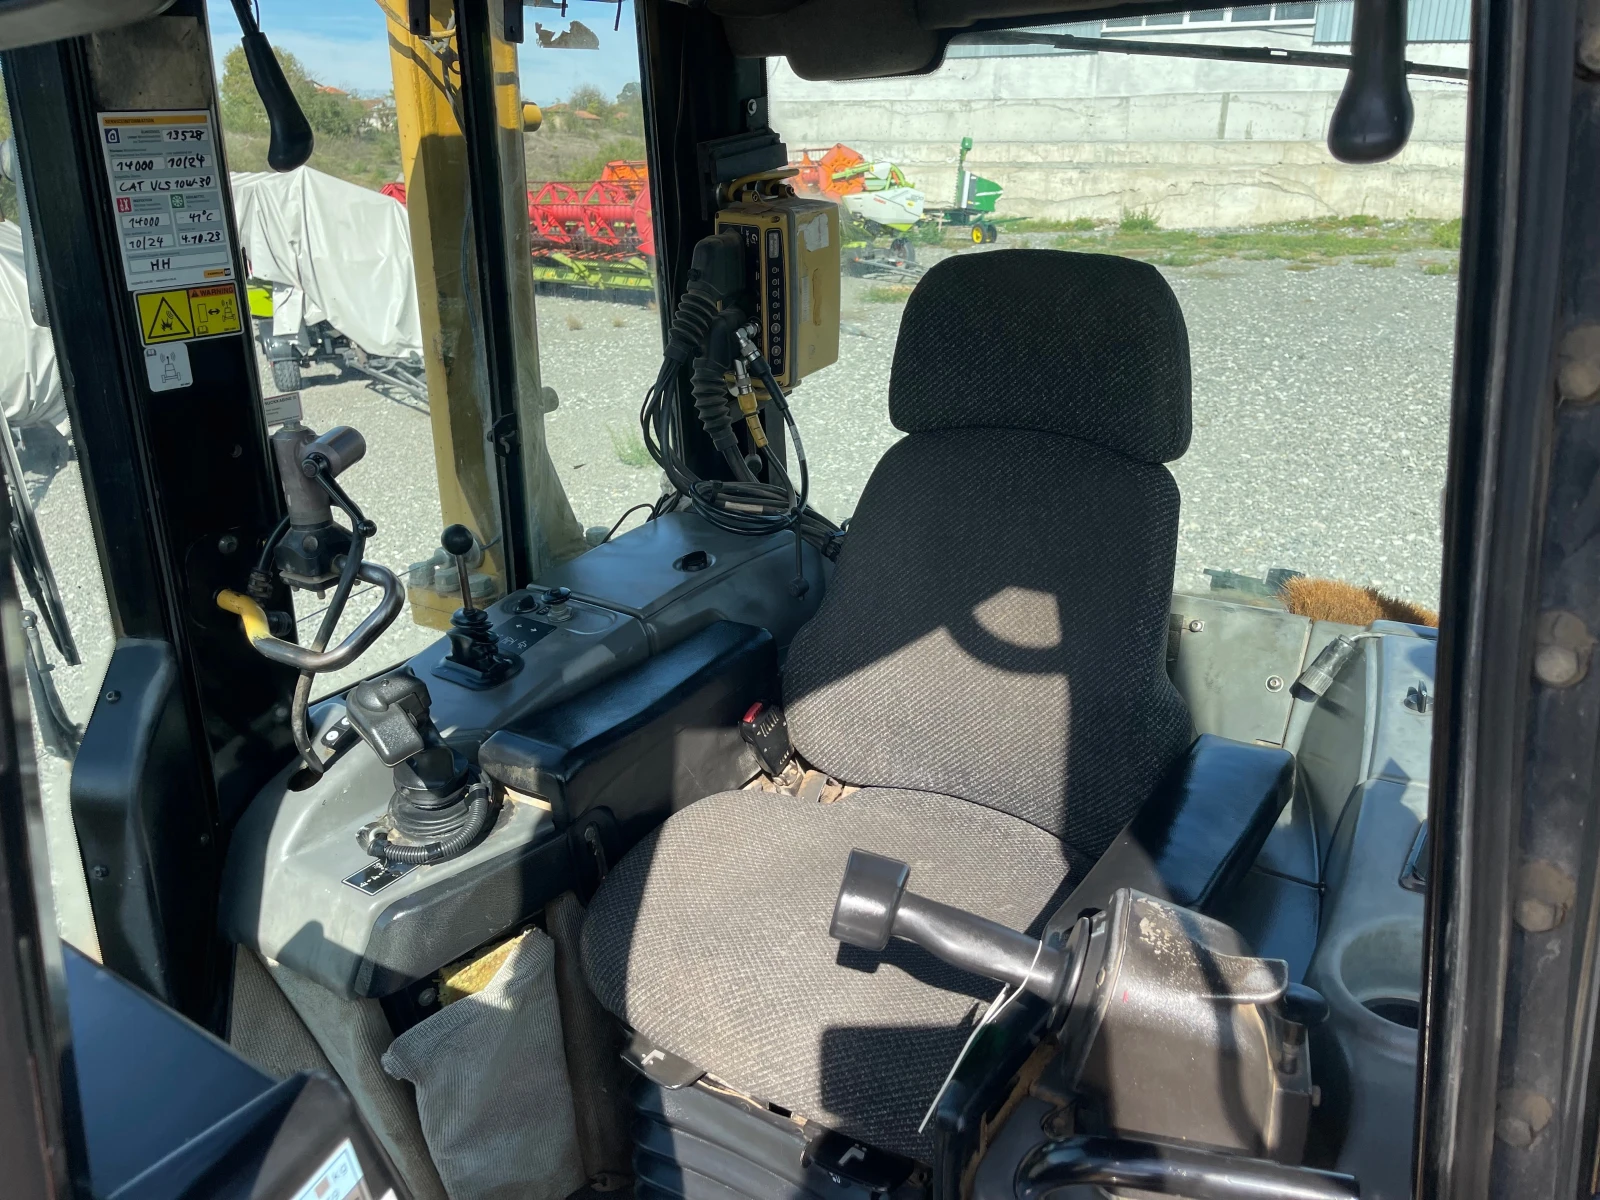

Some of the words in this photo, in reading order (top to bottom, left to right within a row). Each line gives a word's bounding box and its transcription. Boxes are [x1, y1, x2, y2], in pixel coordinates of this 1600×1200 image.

[166, 129, 205, 141] 13528
[116, 160, 154, 171] 14000
[119, 181, 145, 192] CAT
[129, 216, 160, 228] 14000
[129, 236, 164, 250] 10/24
[199, 286, 234, 296] WARNING
